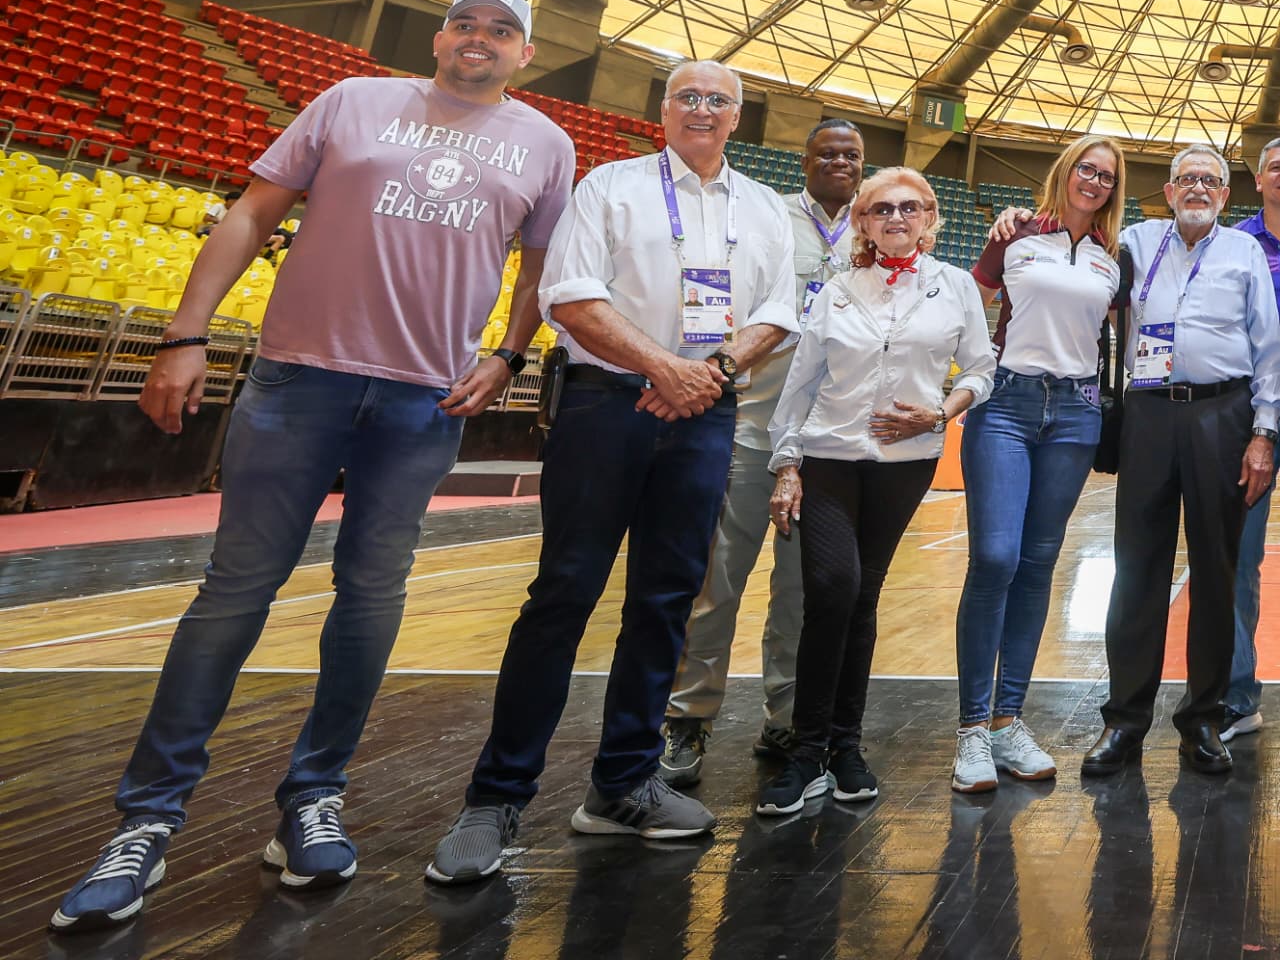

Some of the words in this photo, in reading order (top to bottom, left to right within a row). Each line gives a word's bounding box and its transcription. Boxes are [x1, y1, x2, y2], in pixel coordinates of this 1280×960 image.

[934, 102, 945, 126] L
[377, 117, 529, 177] AMERICAN
[432, 164, 456, 183] 84
